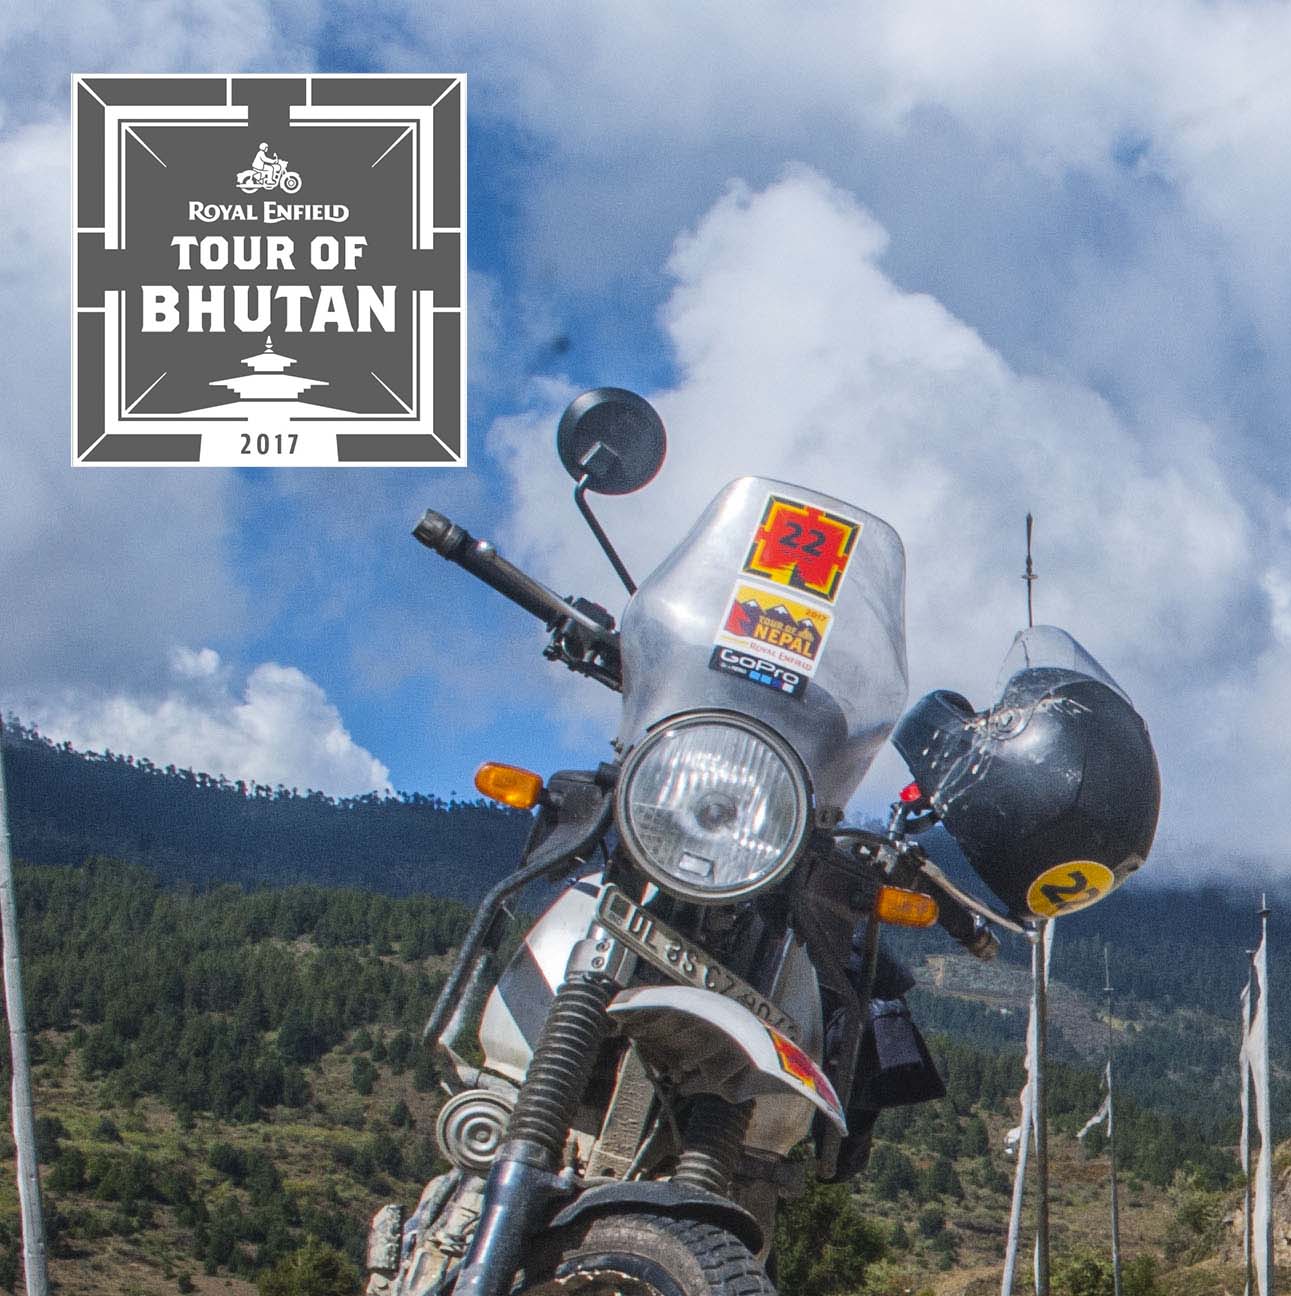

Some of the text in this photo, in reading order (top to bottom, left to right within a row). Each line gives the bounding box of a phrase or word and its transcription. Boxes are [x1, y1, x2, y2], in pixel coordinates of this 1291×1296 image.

[779, 521, 826, 557] 22
[753, 623, 813, 658] NEPAL
[720, 649, 800, 685] GoPro
